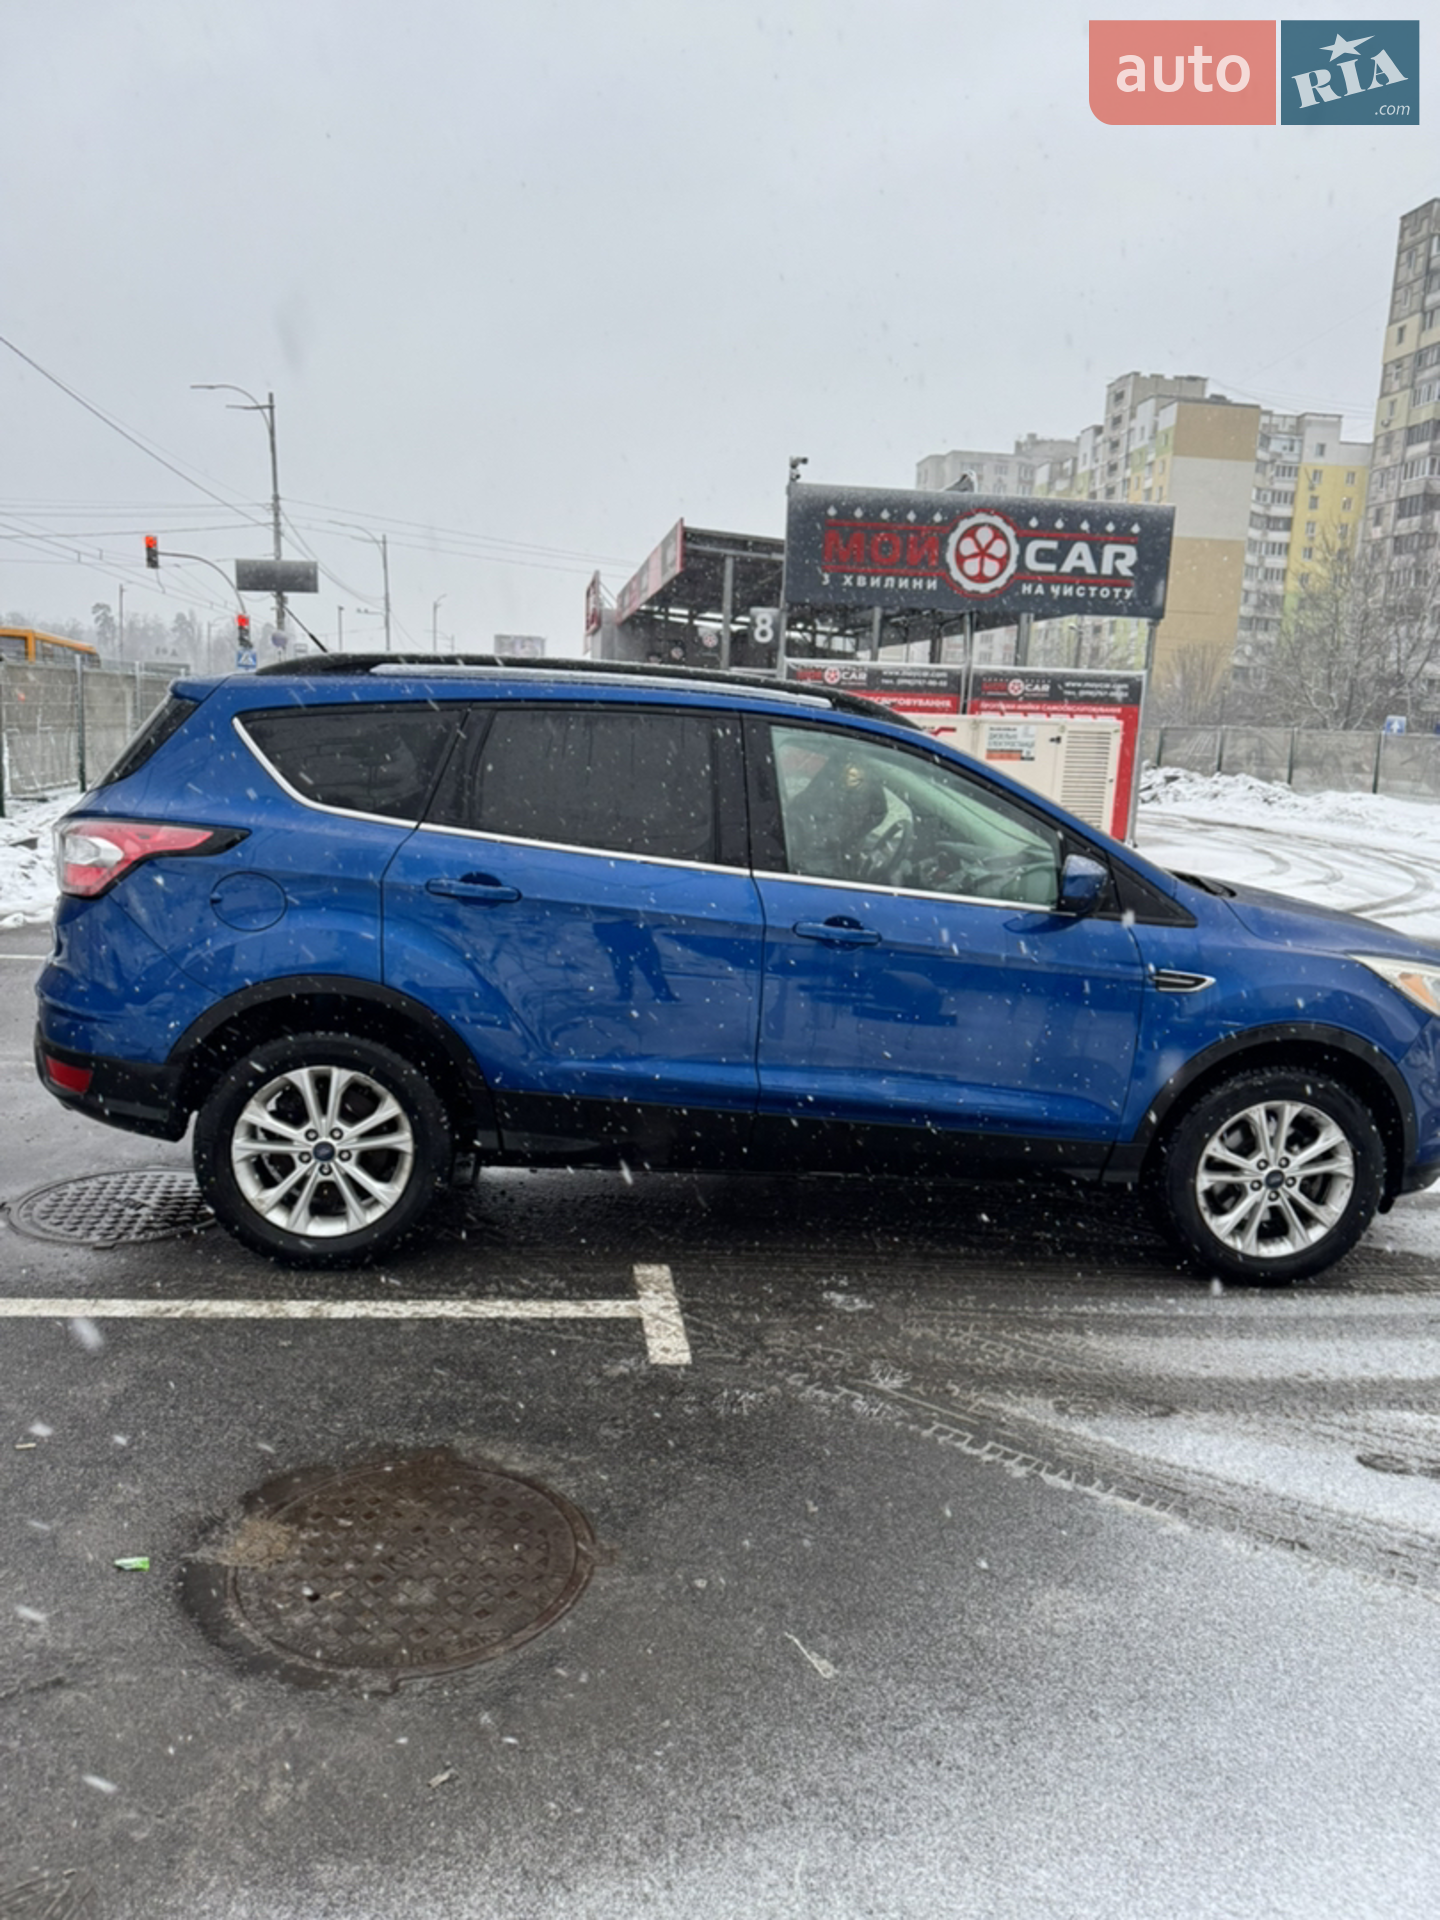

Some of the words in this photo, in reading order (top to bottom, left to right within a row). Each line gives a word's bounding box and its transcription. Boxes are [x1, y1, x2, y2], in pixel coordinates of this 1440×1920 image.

[822, 529, 940, 567] МОЙ
[1024, 539, 1138, 577] CAR
[821, 573, 831, 586] 3
[842, 574, 938, 591] ХВИЛИНИ
[1021, 583, 1045, 596] НА
[1050, 584, 1134, 600] ЧИСТОТУ
[754, 612, 774, 643] 8
[1025, 683, 1051, 692] CAR
